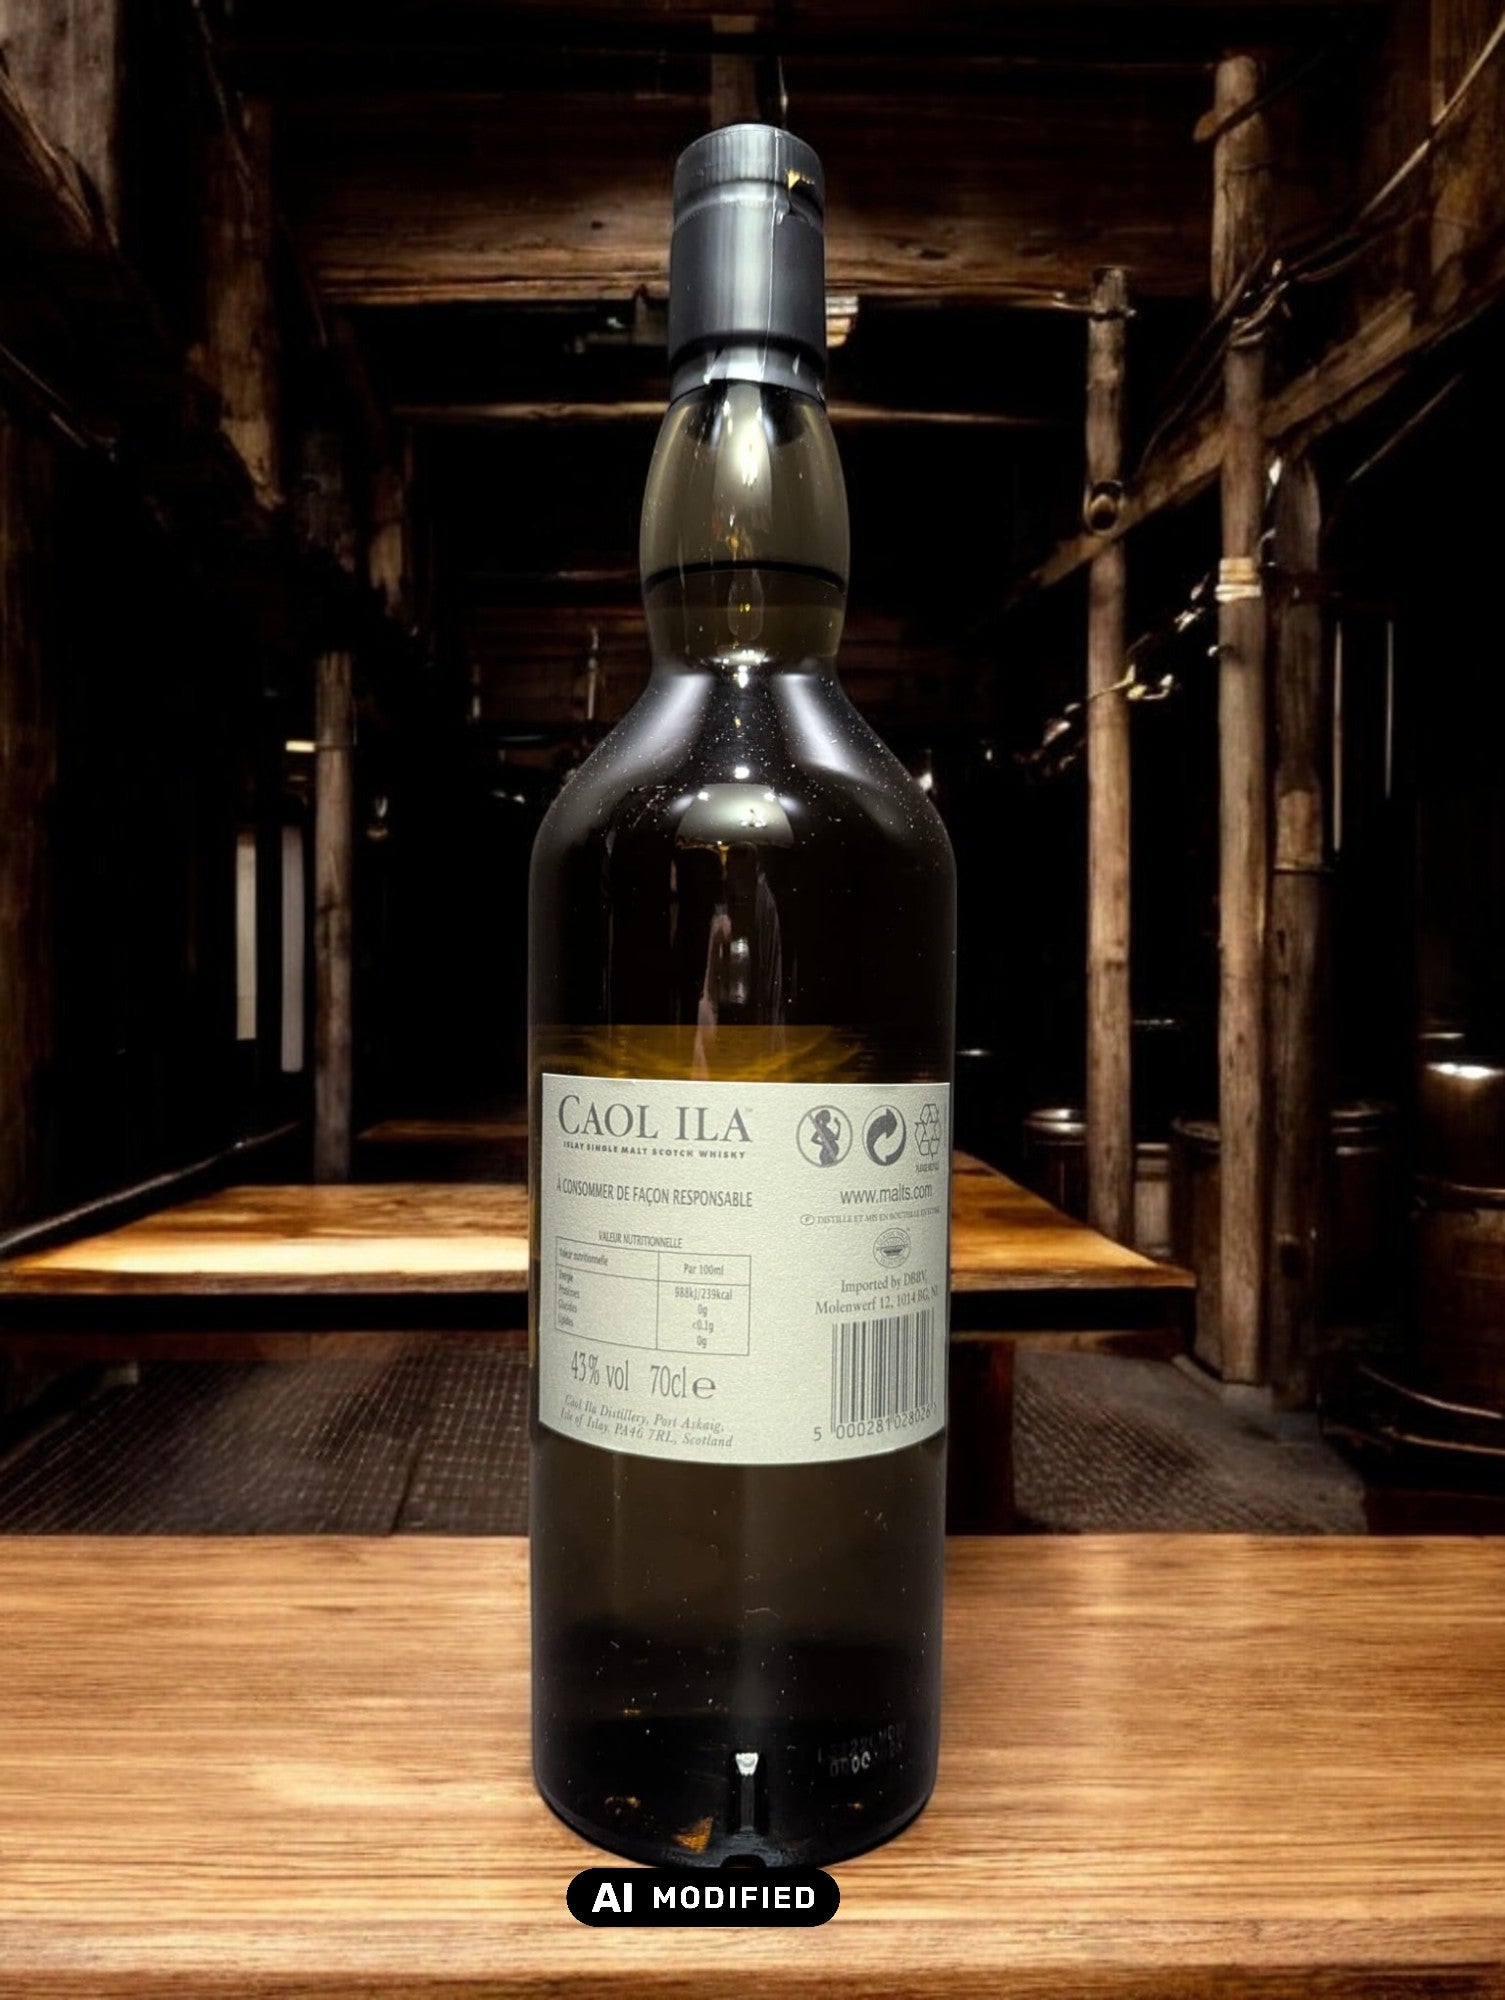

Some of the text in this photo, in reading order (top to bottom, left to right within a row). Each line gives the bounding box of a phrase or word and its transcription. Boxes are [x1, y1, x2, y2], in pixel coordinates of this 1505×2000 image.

[558, 1095, 752, 1142] CAOL ILA
[563, 1141, 746, 1159] ISLAY SINGLE MALT SCOTCH WHISKY
[562, 1178, 614, 1200] CONSOMMER
[617, 1185, 630, 1201] DE
[633, 1187, 669, 1206] FAÇON
[673, 1190, 753, 1207] RESPONSABLE
[840, 1183, 933, 1205] www.malts.com
[598, 1230, 683, 1249] VALEUR NUTRITIONNELLE
[684, 1263, 724, 1276] Par 100ml
[674, 1286, 733, 1301] 988kJ/239kcal
[841, 1275, 888, 1295] Imported
[891, 1275, 902, 1290] by
[697, 1303, 708, 1317] 0g
[815, 1298, 876, 1315] Molenwerf
[880, 1295, 894, 1309] 12,
[897, 1291, 916, 1307] 1014
[696, 1335, 708, 1349] 0g
[570, 1350, 600, 1386] 43%
[606, 1359, 629, 1391] vol
[650, 1365, 686, 1398] 70cl
[564, 1394, 725, 1434] Caol Ila Distillery, Port Askaig,
[560, 1407, 573, 1421] Isle
[574, 1413, 585, 1428] of
[614, 1422, 645, 1439] PA46
[648, 1428, 678, 1446] 7RL,
[682, 1432, 734, 1448] Scotland
[813, 1426, 822, 1442] 5
